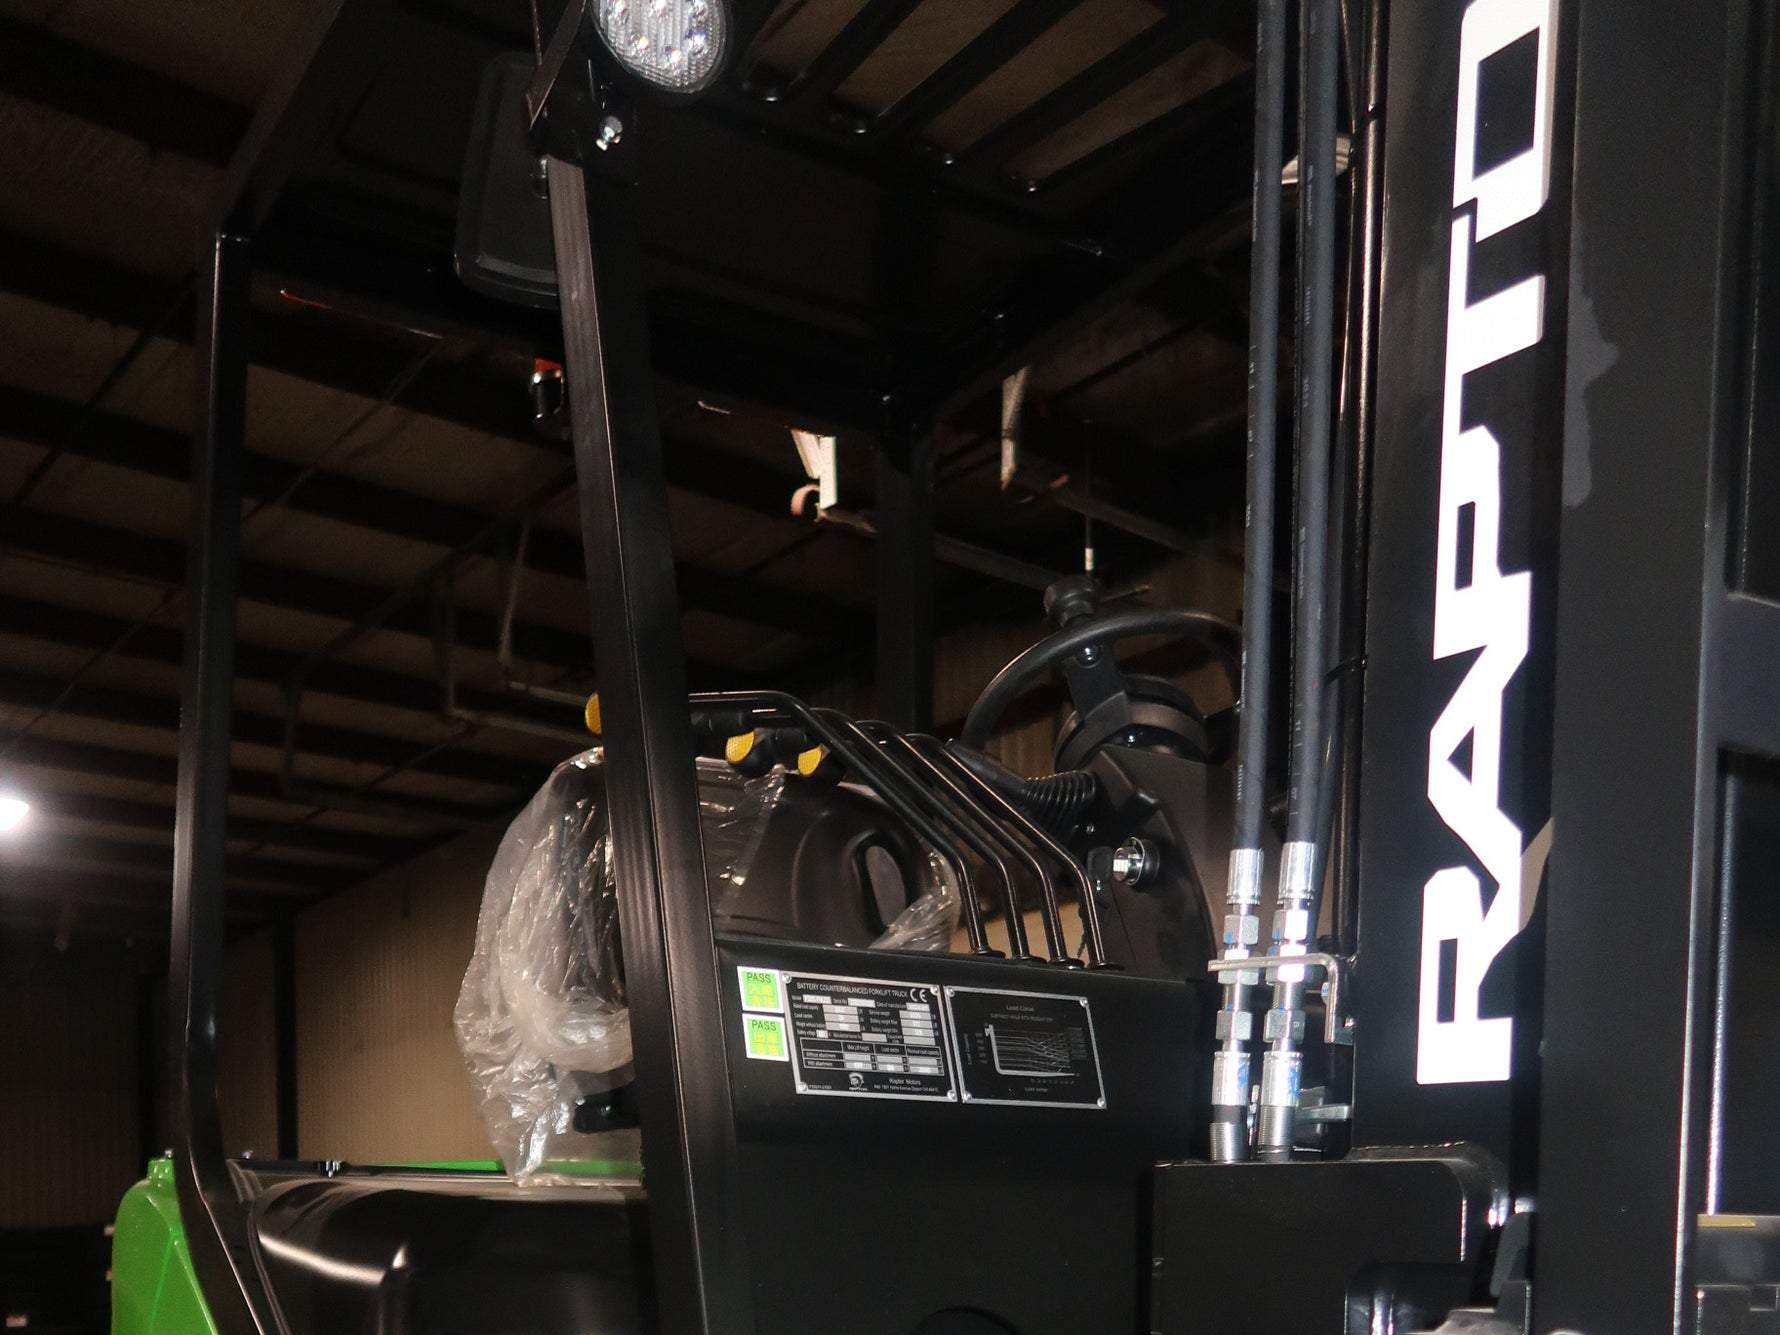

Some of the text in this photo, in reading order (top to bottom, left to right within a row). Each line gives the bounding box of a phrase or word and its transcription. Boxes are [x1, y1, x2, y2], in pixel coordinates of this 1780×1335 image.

[746, 972, 771, 984] PASS
[796, 982, 819, 991] BATTERY
[820, 984, 868, 994] COUNTERBALANCED
[869, 988, 891, 996] FORKLIFT
[909, 988, 928, 1003] CE
[751, 1019, 777, 1031] PASS
